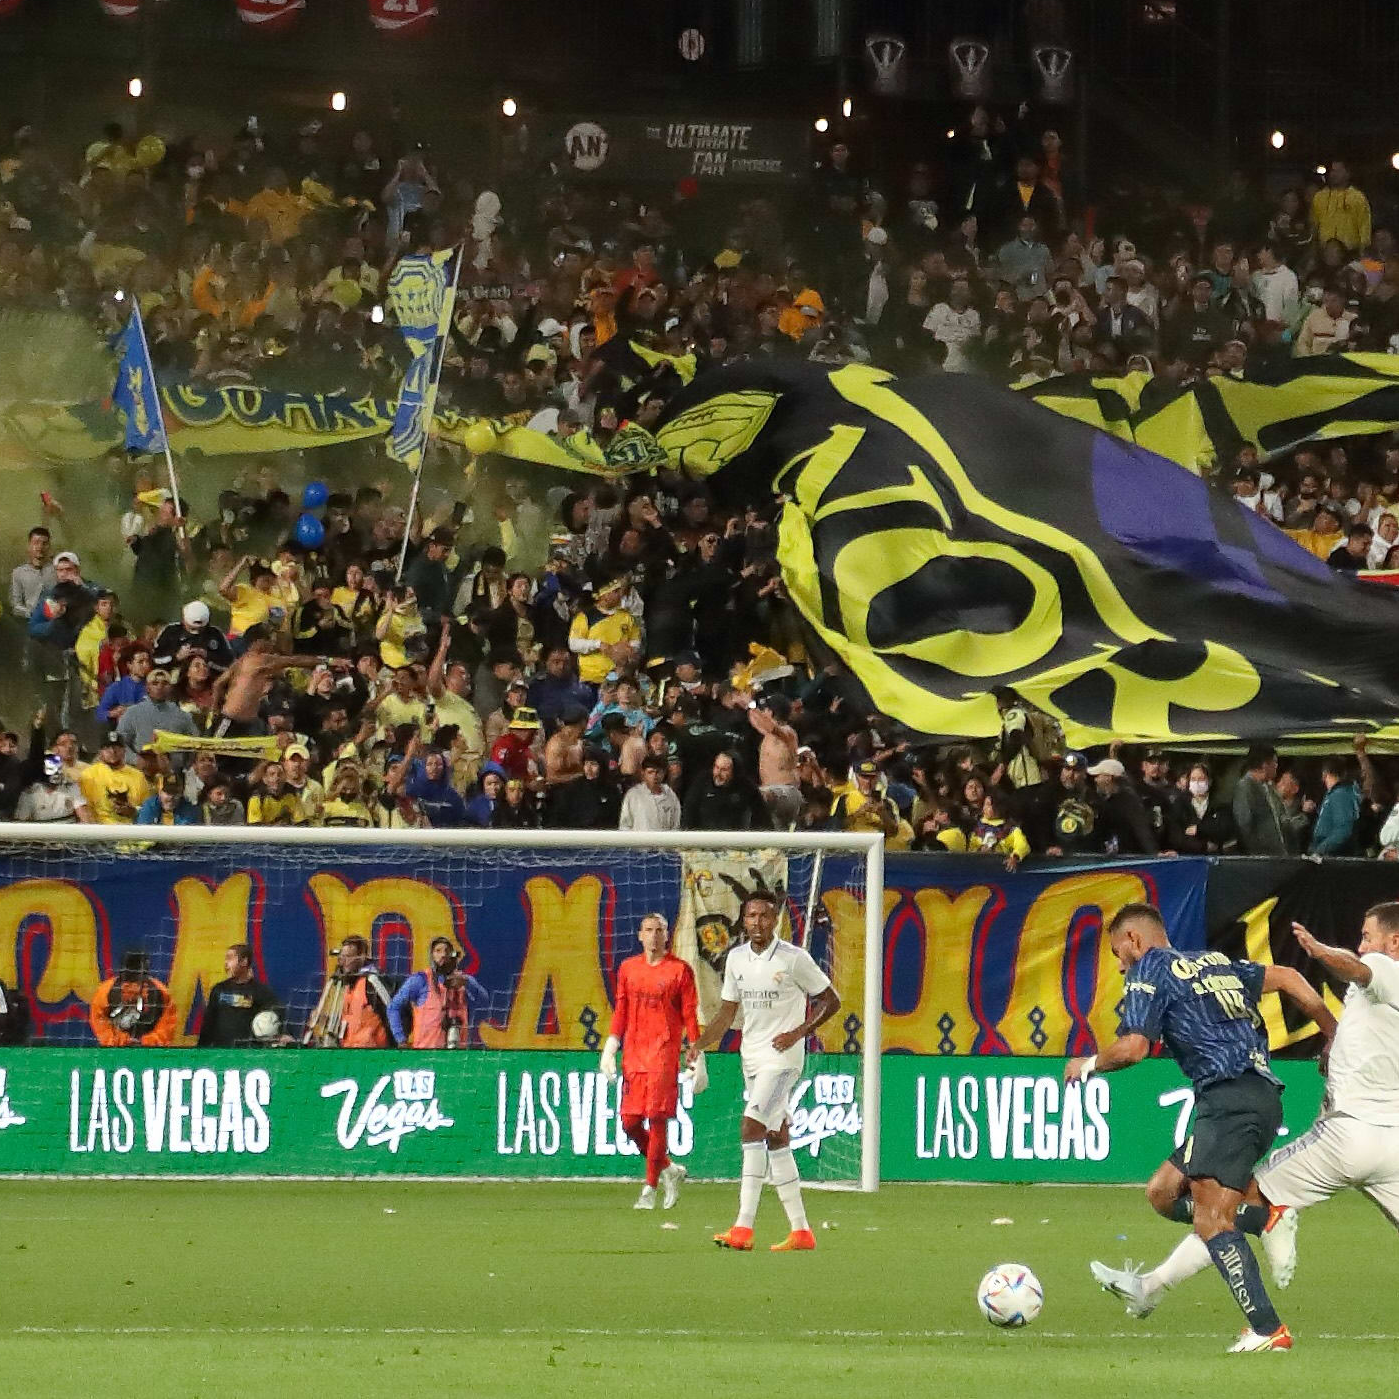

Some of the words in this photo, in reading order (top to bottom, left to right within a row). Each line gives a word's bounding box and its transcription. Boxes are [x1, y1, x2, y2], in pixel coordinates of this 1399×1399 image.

[666, 123, 752, 150] ULTIMATE
[692, 151, 729, 176] FAN
[69, 1068, 135, 1153] LAS
[141, 1069, 271, 1154] VEGAS
[320, 1072, 454, 1154] Vegas
[497, 1071, 561, 1155] LAS
[916, 1076, 980, 1160] LAS
[987, 1077, 1110, 1161] VEGAS
